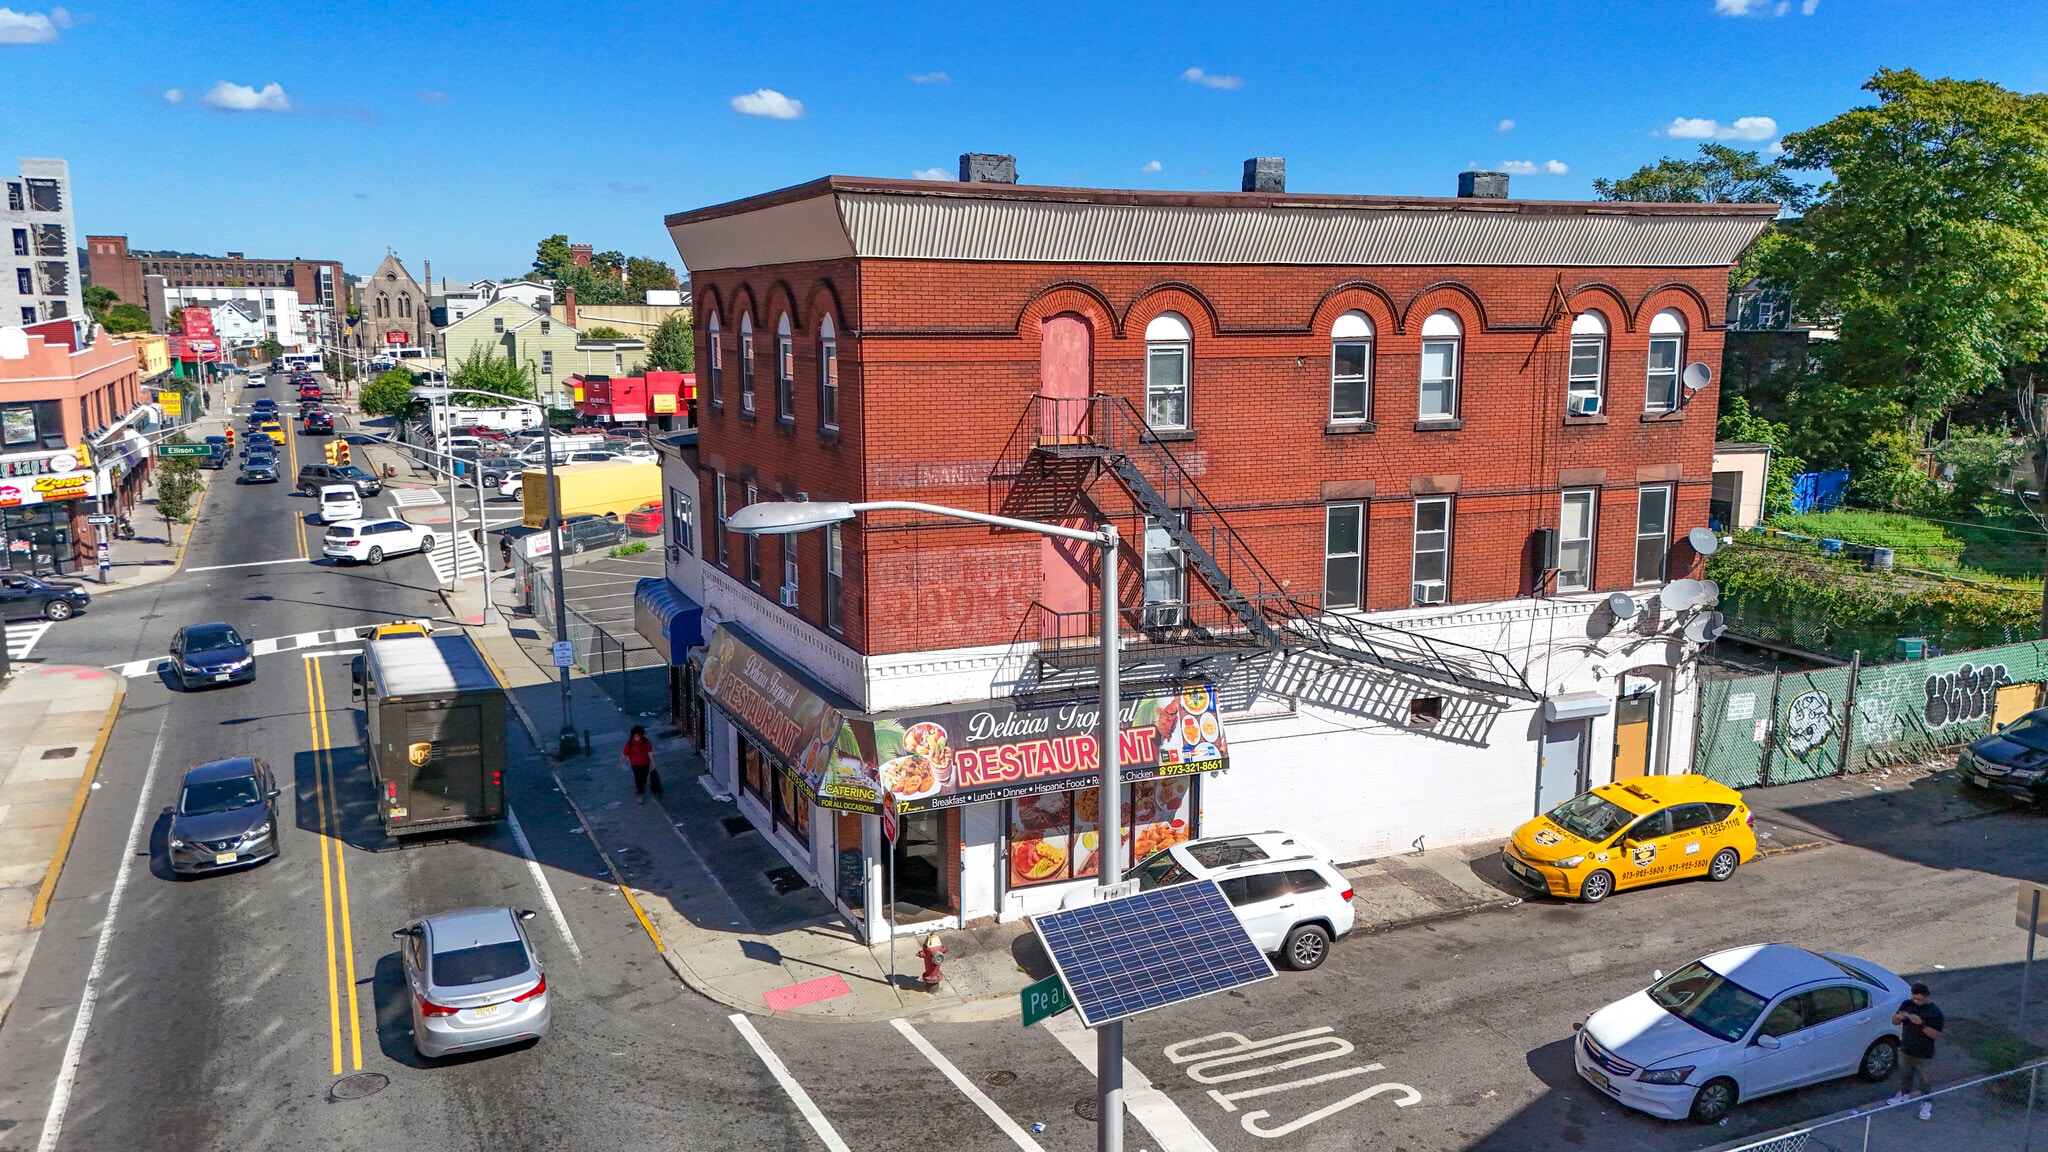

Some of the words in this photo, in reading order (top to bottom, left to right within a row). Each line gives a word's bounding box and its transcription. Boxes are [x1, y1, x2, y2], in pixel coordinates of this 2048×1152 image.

[168, 446, 195, 455] Ellison
[33, 475, 93, 492] Ziggy's
[742, 654, 769, 692] Delicias
[766, 671, 800, 710] Tropical
[720, 673, 802, 757] RESTAURANT
[965, 711, 1049, 743] Delicias
[1056, 699, 1139, 736] Tropal
[411, 749, 430, 764] ups
[954, 724, 1157, 789] RESTAURNT
[1166, 760, 1223, 775] 973-321-8661
[825, 784, 876, 800] CATERING
[932, 794, 966, 808] Breakfast
[973, 791, 996, 802] Lunch
[1003, 788, 1027, 798] Dinner
[1034, 781, 1066, 794] Hispanic
[1066, 779, 1086, 788] Food
[1125, 770, 1154, 781] Chicken
[821, 799, 832, 807] FOR
[843, 802, 875, 813] OCCASIONS
[1700, 818, 1740, 836] 973-925-1110
[1163, 1026, 1422, 1139] STOP
